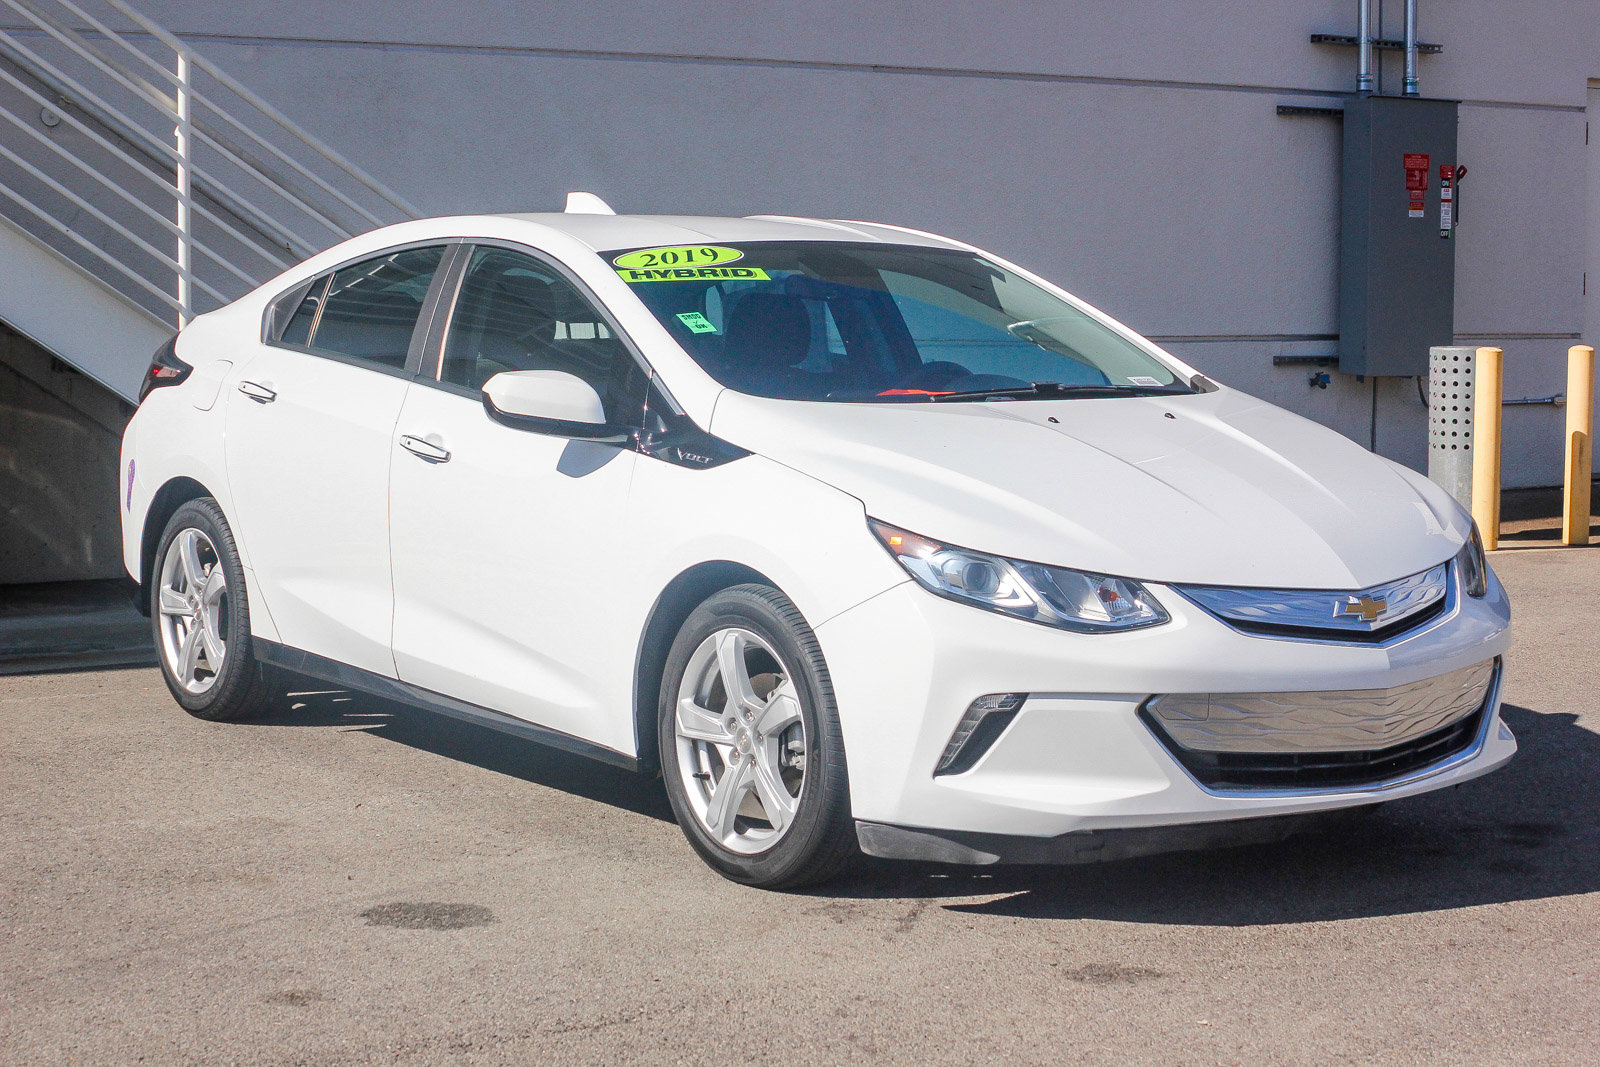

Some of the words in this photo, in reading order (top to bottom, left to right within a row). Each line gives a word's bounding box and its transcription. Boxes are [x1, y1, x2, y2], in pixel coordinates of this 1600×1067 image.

[639, 248, 719, 267] 2019
[629, 268, 757, 280] HYBRID
[677, 448, 713, 463] VOLT
